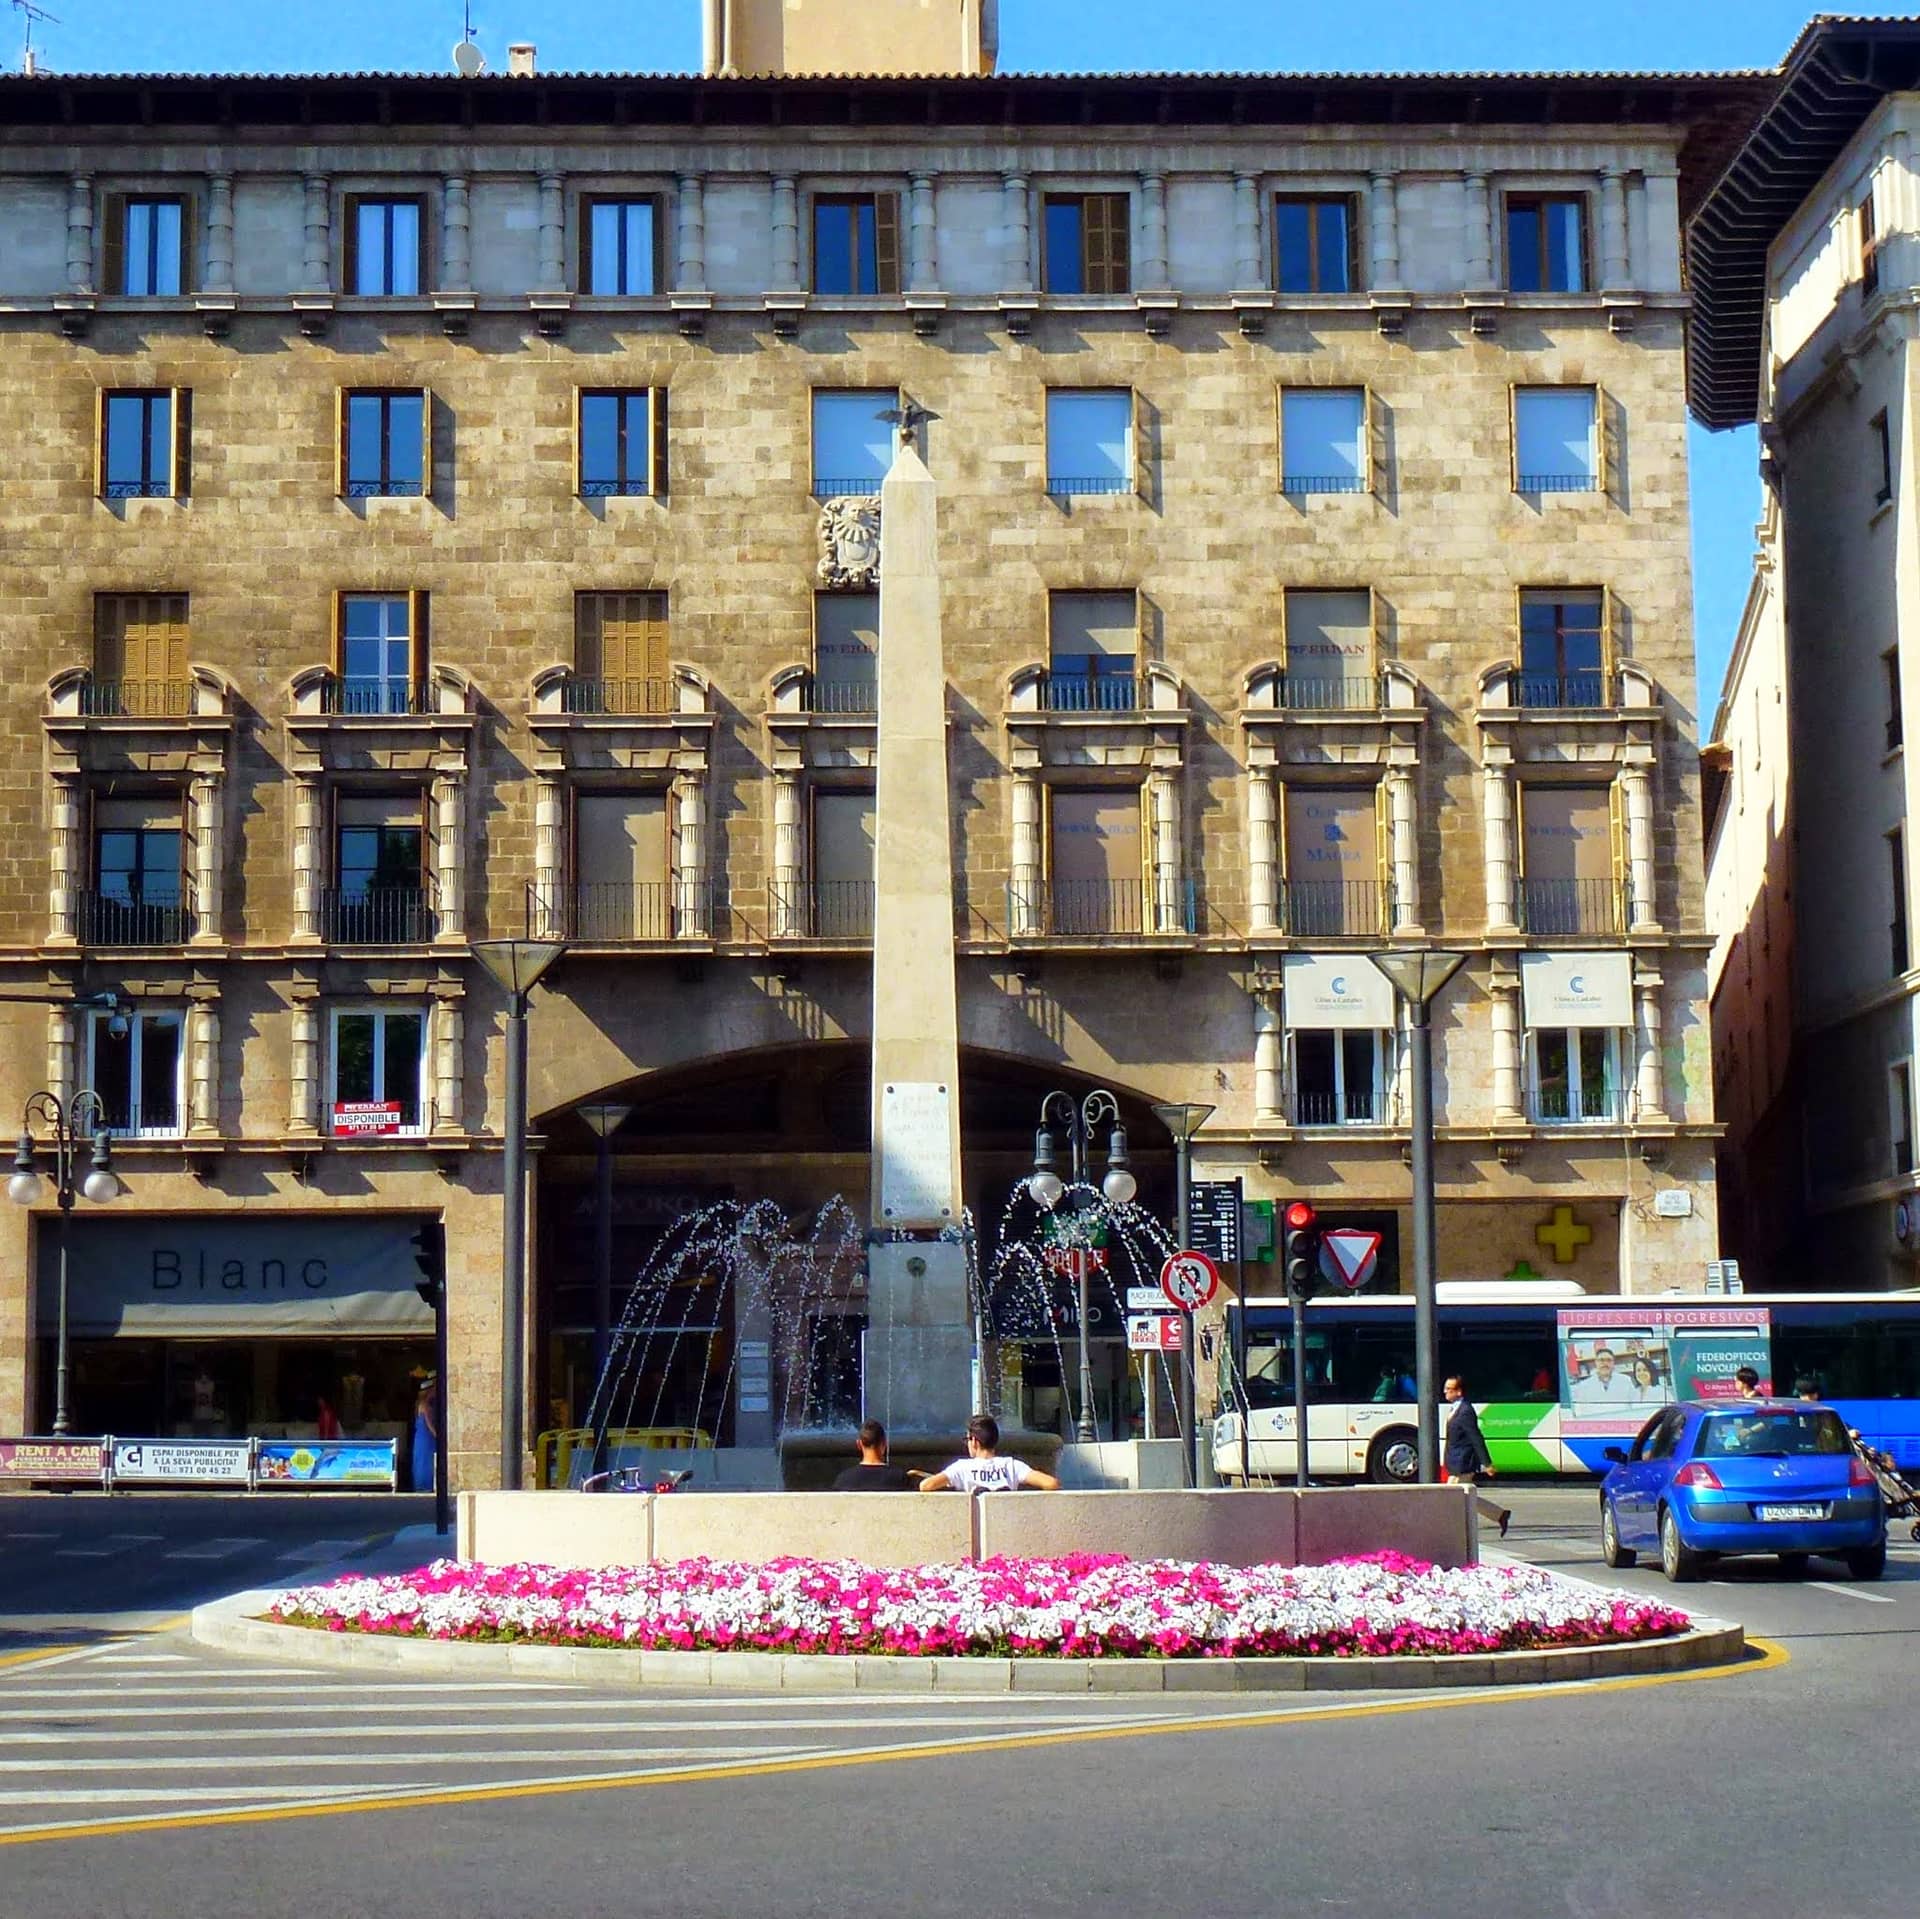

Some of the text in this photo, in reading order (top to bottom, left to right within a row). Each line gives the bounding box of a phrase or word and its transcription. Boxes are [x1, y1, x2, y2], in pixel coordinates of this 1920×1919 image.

[337, 1114, 397, 1123] DISPONIBLE
[153, 1250, 328, 1289] Blanc
[1655, 1311, 1767, 1323] PROGRESIVOS
[16, 1446, 100, 1456] RENT A CAR
[176, 1449, 221, 1457] DISPONIBLE
